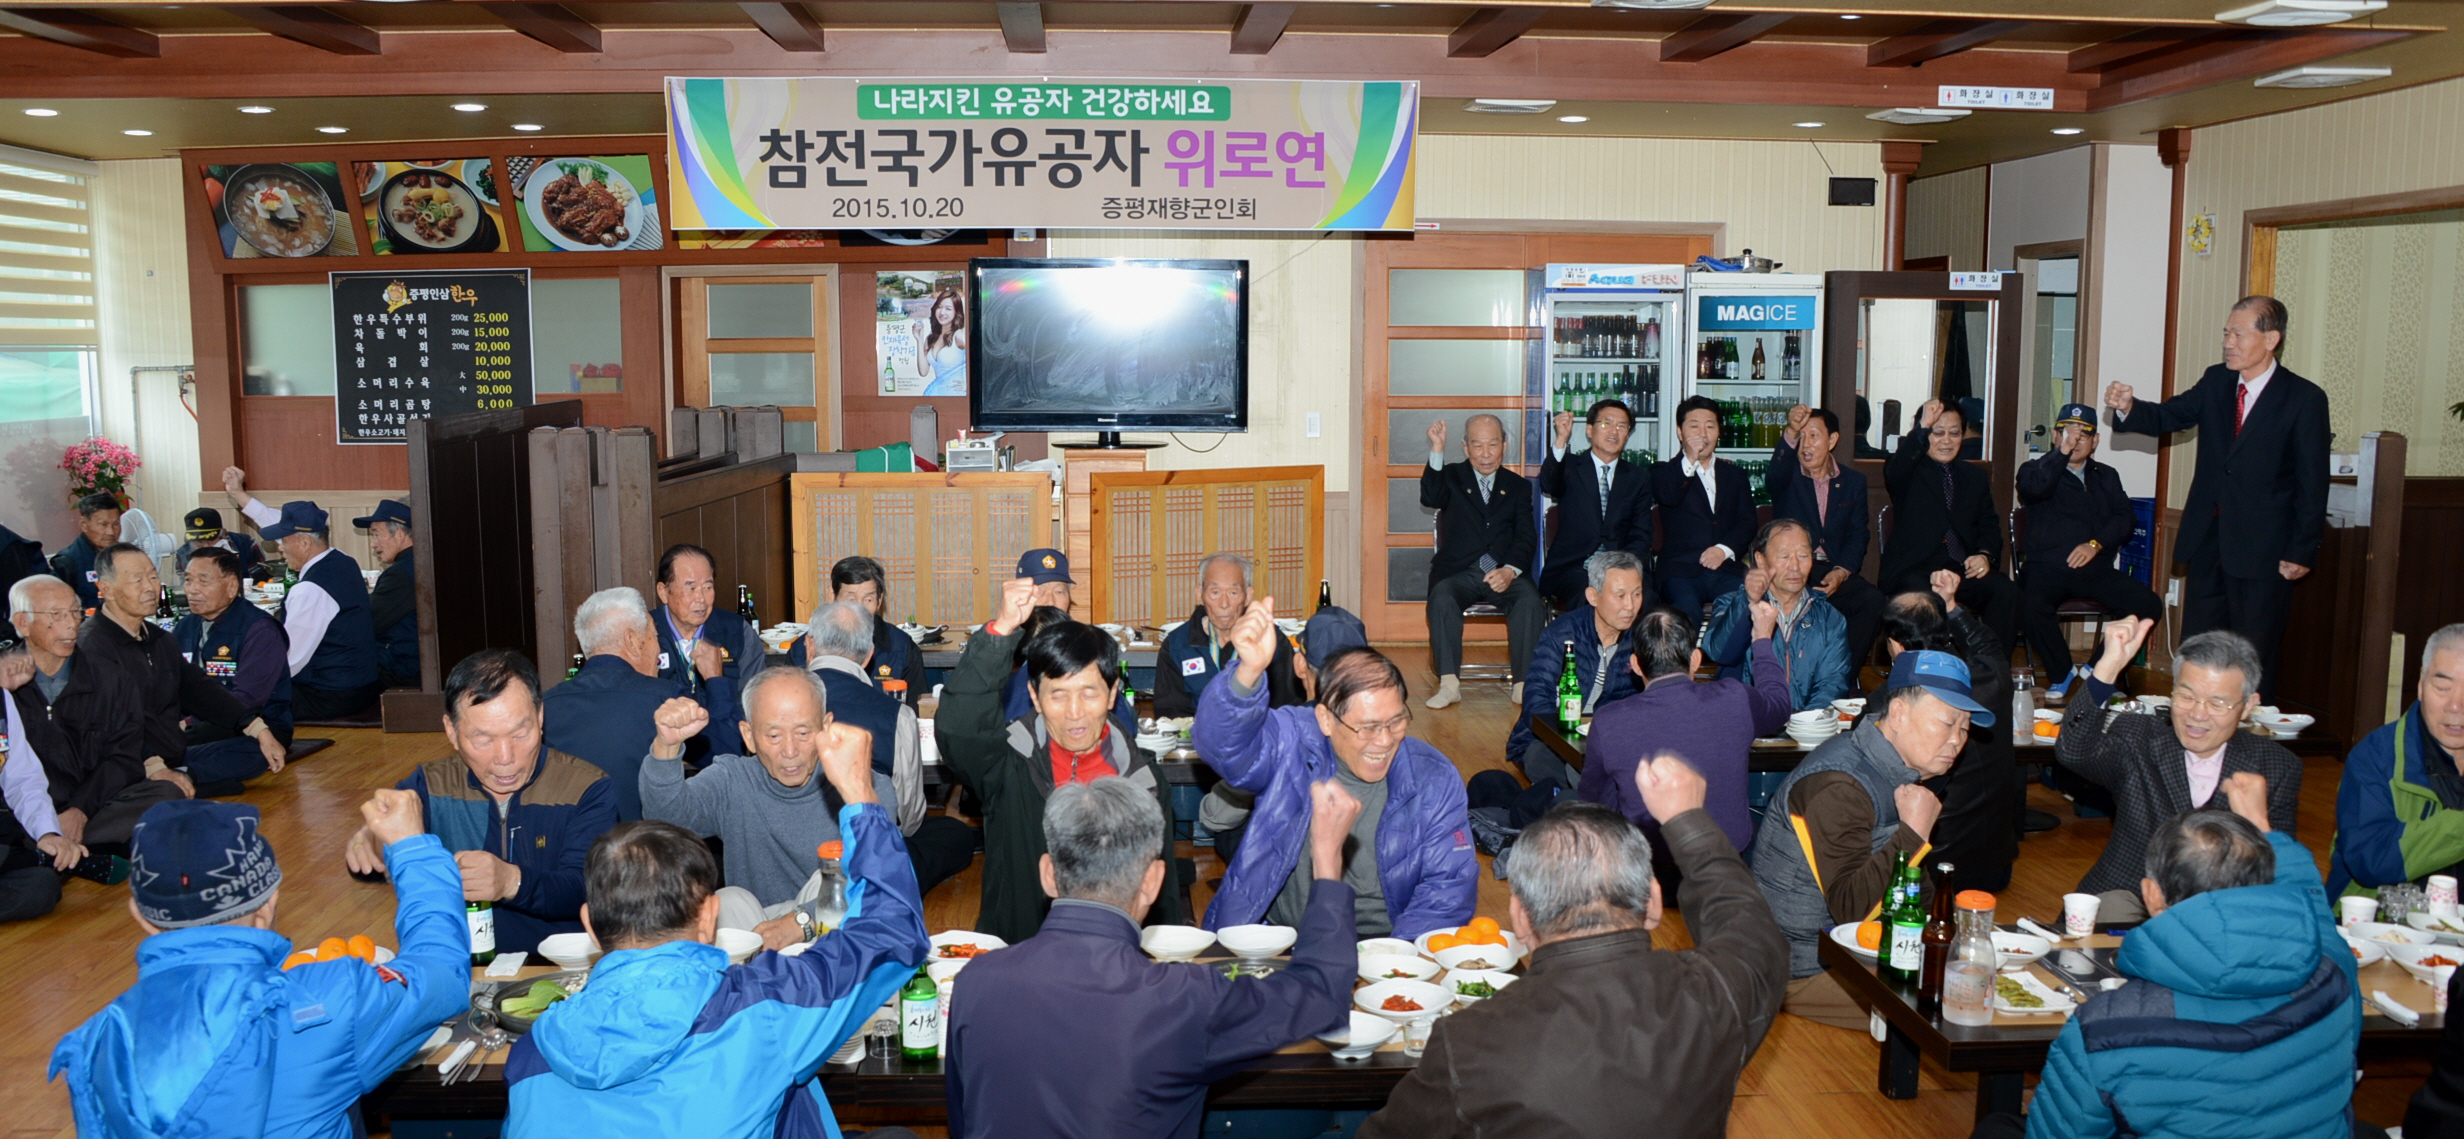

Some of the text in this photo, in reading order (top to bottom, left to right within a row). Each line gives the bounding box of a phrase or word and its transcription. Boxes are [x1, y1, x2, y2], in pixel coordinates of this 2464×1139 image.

[1959, 88, 1994, 99] 화장실
[2016, 90, 2050, 101] 화장실
[874, 87, 1215, 118] 나라지킨 유공자 건강하세요
[758, 127, 1327, 190] 참전국가유공자 위로연
[831, 197, 965, 220] 2015.10.20
[1100, 196, 1257, 222] 증평재향군인회
[1588, 272, 1636, 286] Aqua
[1968, 274, 1999, 283] 화장실
[408, 284, 479, 307] 증평인삼 한우
[352, 312, 509, 326] 한우특수부위 200g 25,000
[1717, 303, 1797, 322] MAGICE
[354, 327, 510, 340] 차돌박이 200g 15,000
[451, 342, 470, 352] 200g
[474, 341, 511, 353] 20,000
[356, 356, 511, 369] 삼겹살 10,000
[475, 370, 512, 381] 50,000
[357, 377, 431, 390] 소머리수육
[476, 384, 513, 396] 30,000
[358, 398, 513, 411] 소머리곰탕 6,000
[199, 856, 273, 902] CANADA
